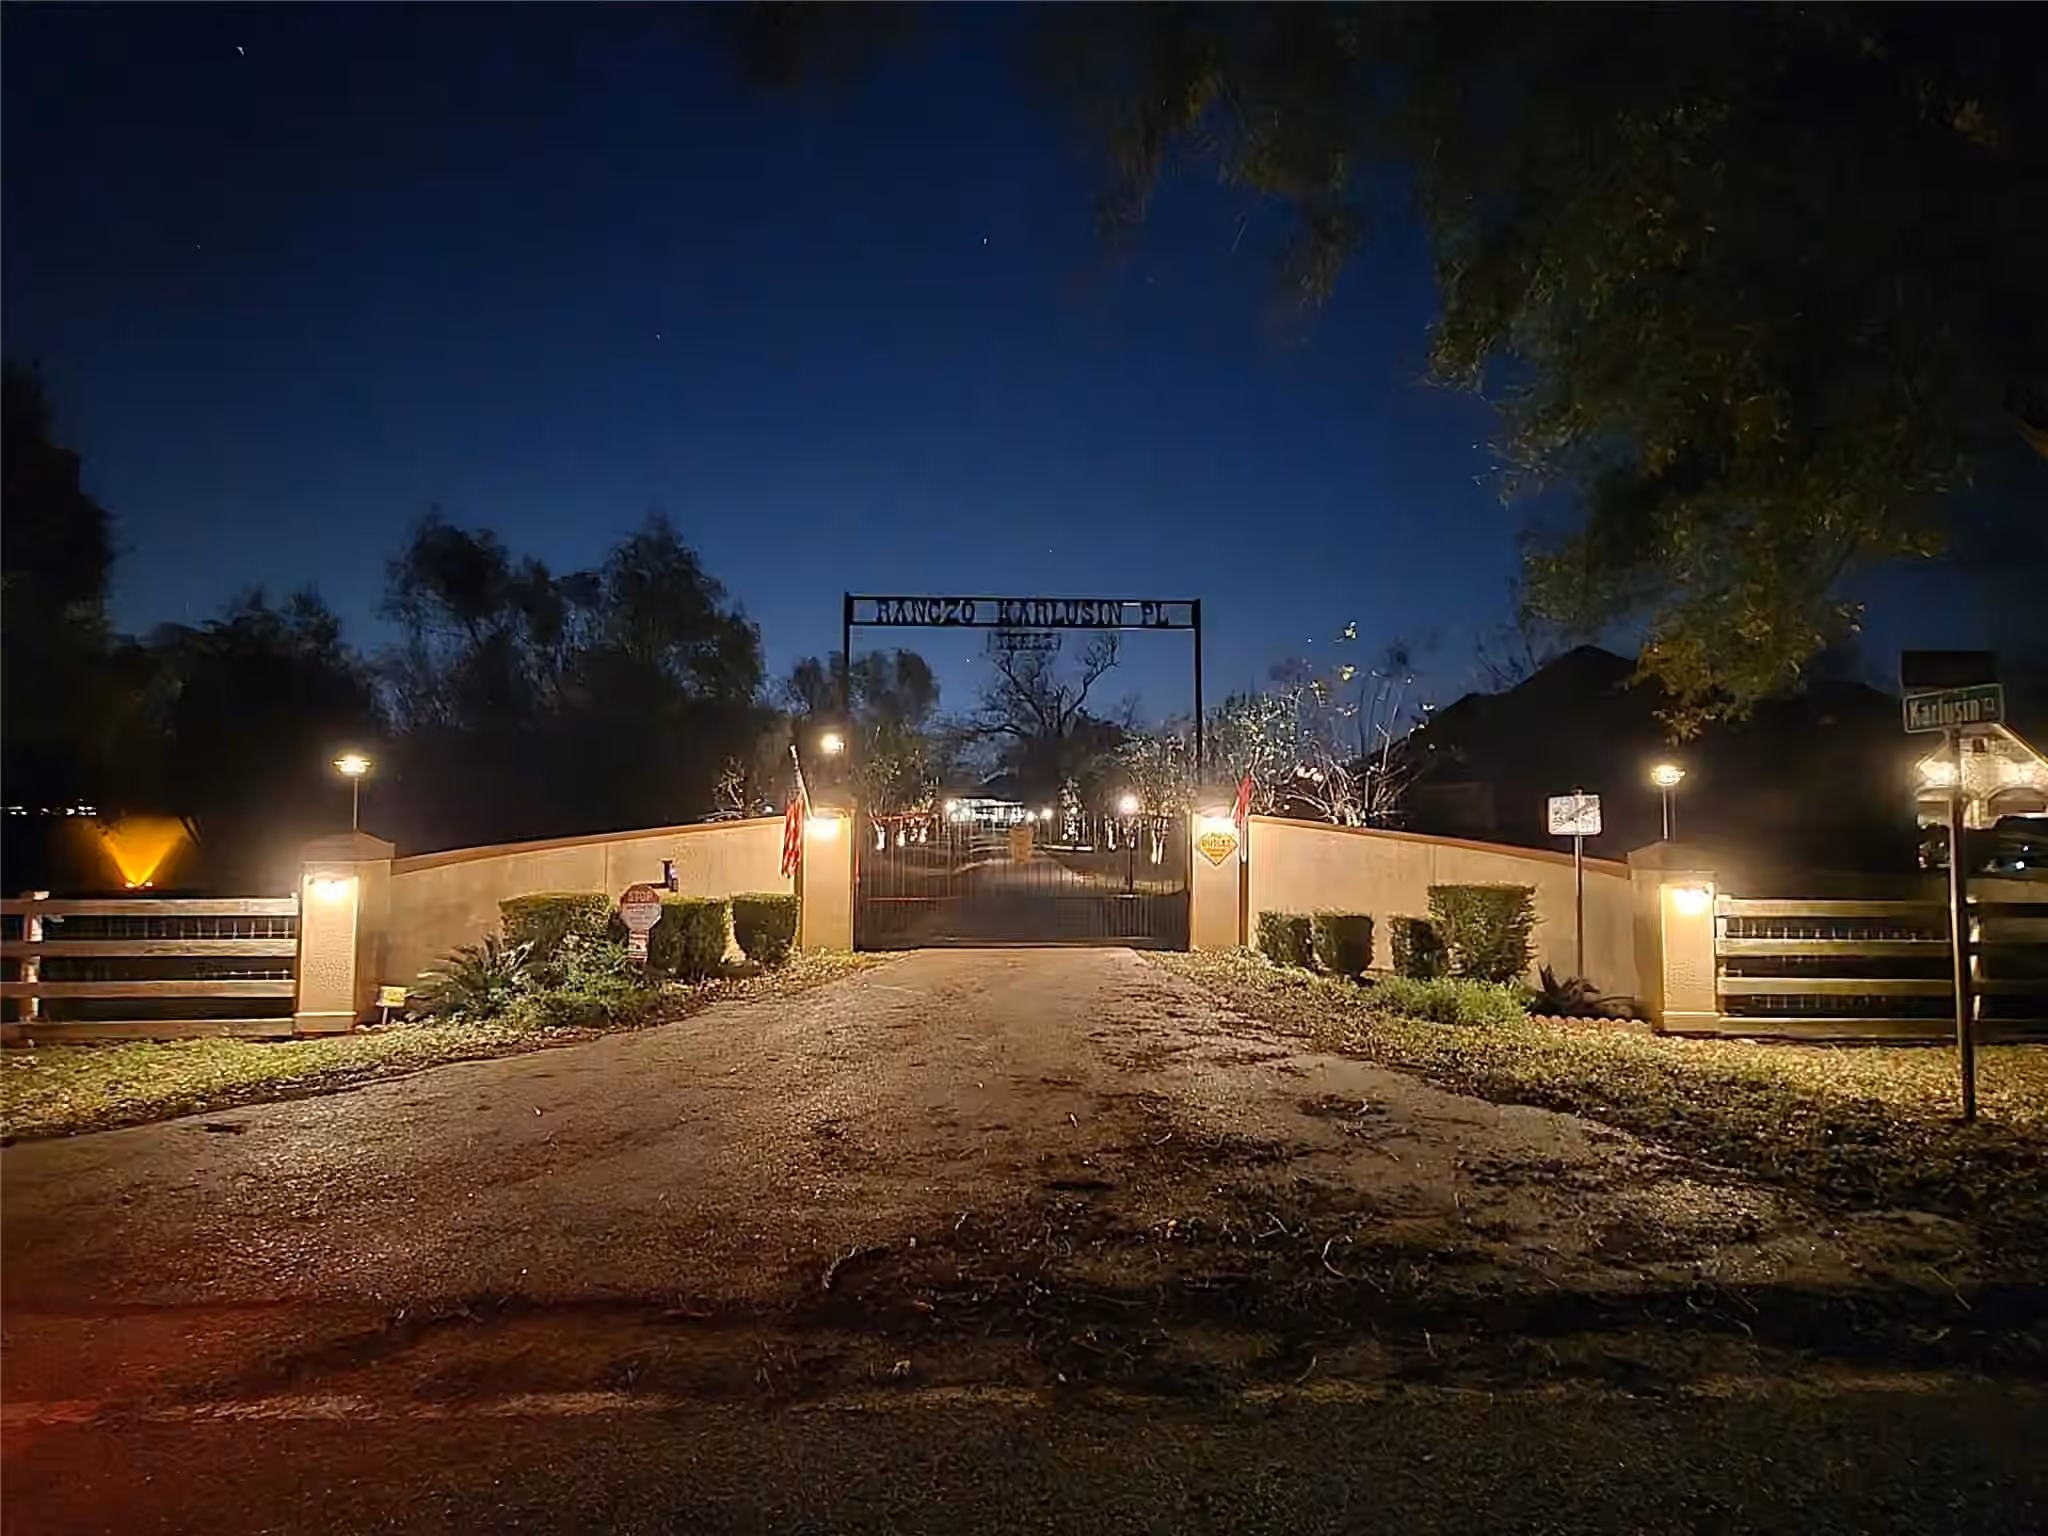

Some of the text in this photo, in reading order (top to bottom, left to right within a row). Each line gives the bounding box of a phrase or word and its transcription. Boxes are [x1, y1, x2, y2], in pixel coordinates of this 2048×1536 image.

[875, 598, 976, 625] RANCZO
[1909, 695, 1980, 728] Karlusin
[628, 890, 654, 902] STOP
